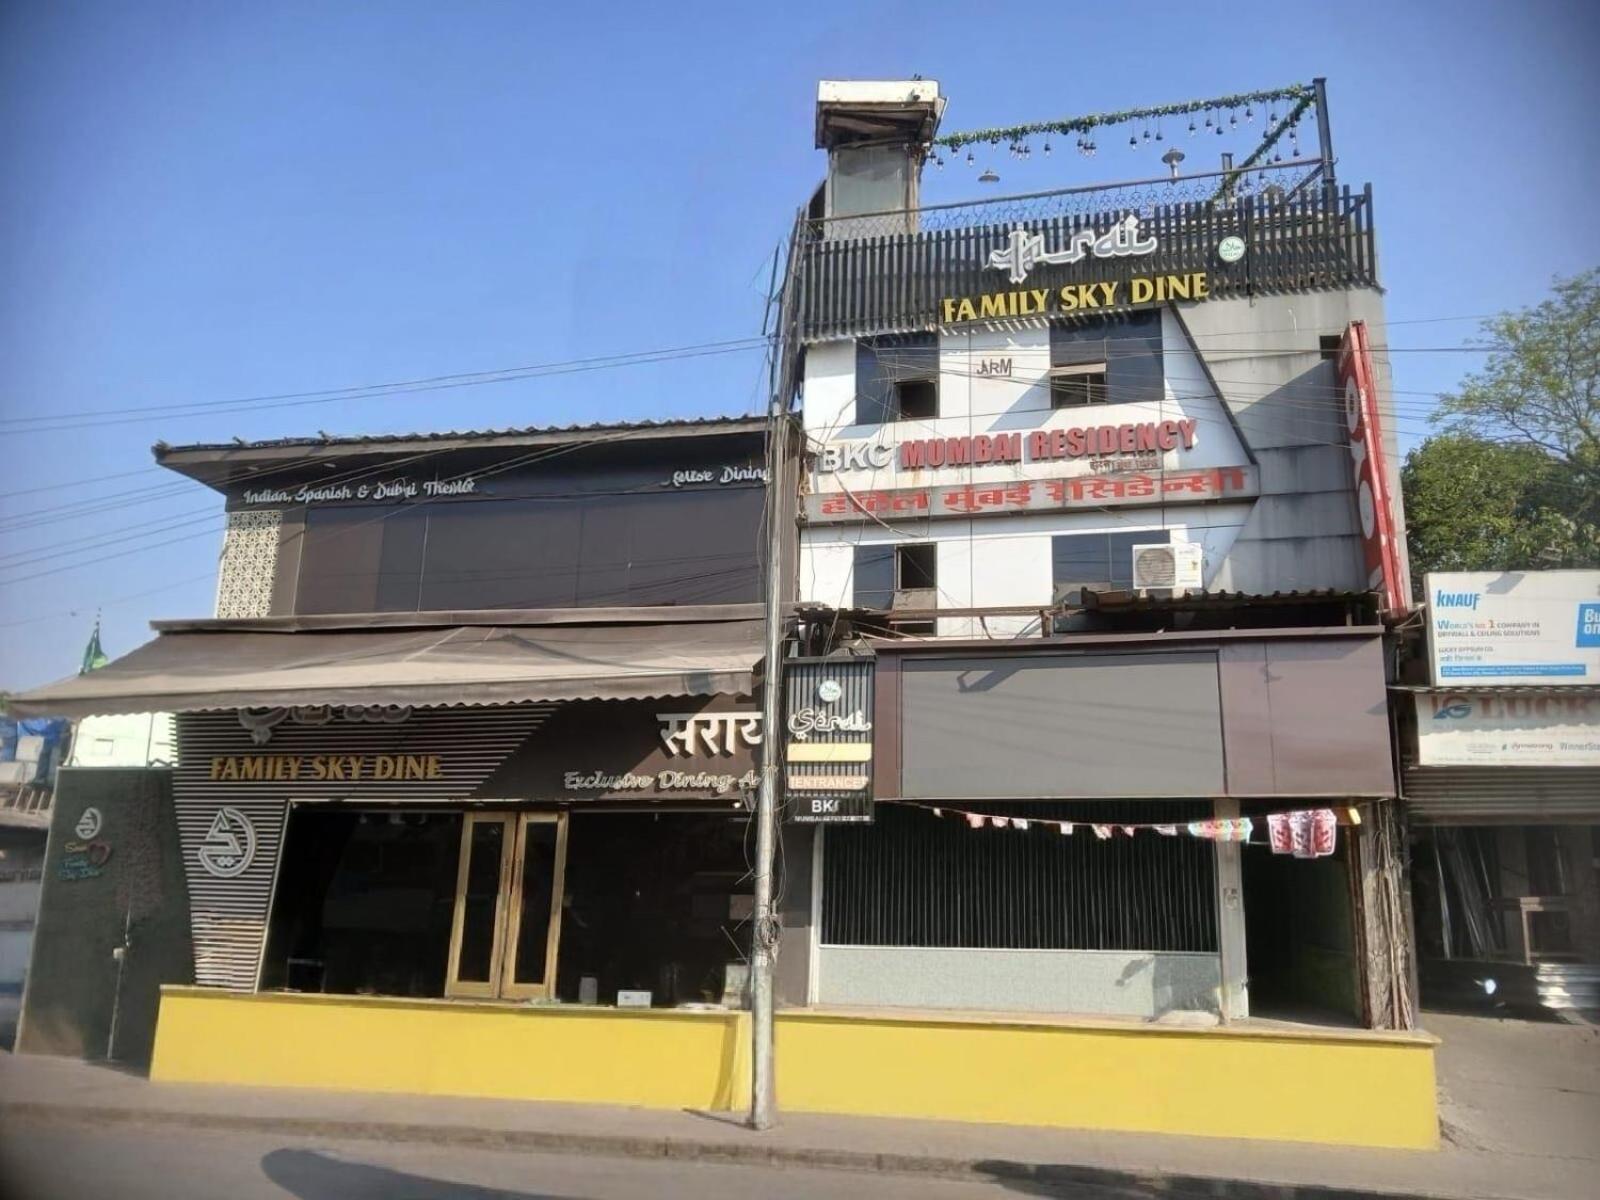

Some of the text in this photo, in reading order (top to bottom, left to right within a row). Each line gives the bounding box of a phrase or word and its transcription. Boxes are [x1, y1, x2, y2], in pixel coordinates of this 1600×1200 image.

[943, 272, 1210, 323] FAMILY SKY DINE
[820, 419, 1197, 473] BKC MUMBAI RESIDENCY
[295, 485, 352, 504] Spanish
[357, 486, 370, 499] &
[208, 755, 444, 781] FAMILY SKY DINE
[564, 770, 653, 790] Exclusive
[658, 770, 735, 794] Dining
